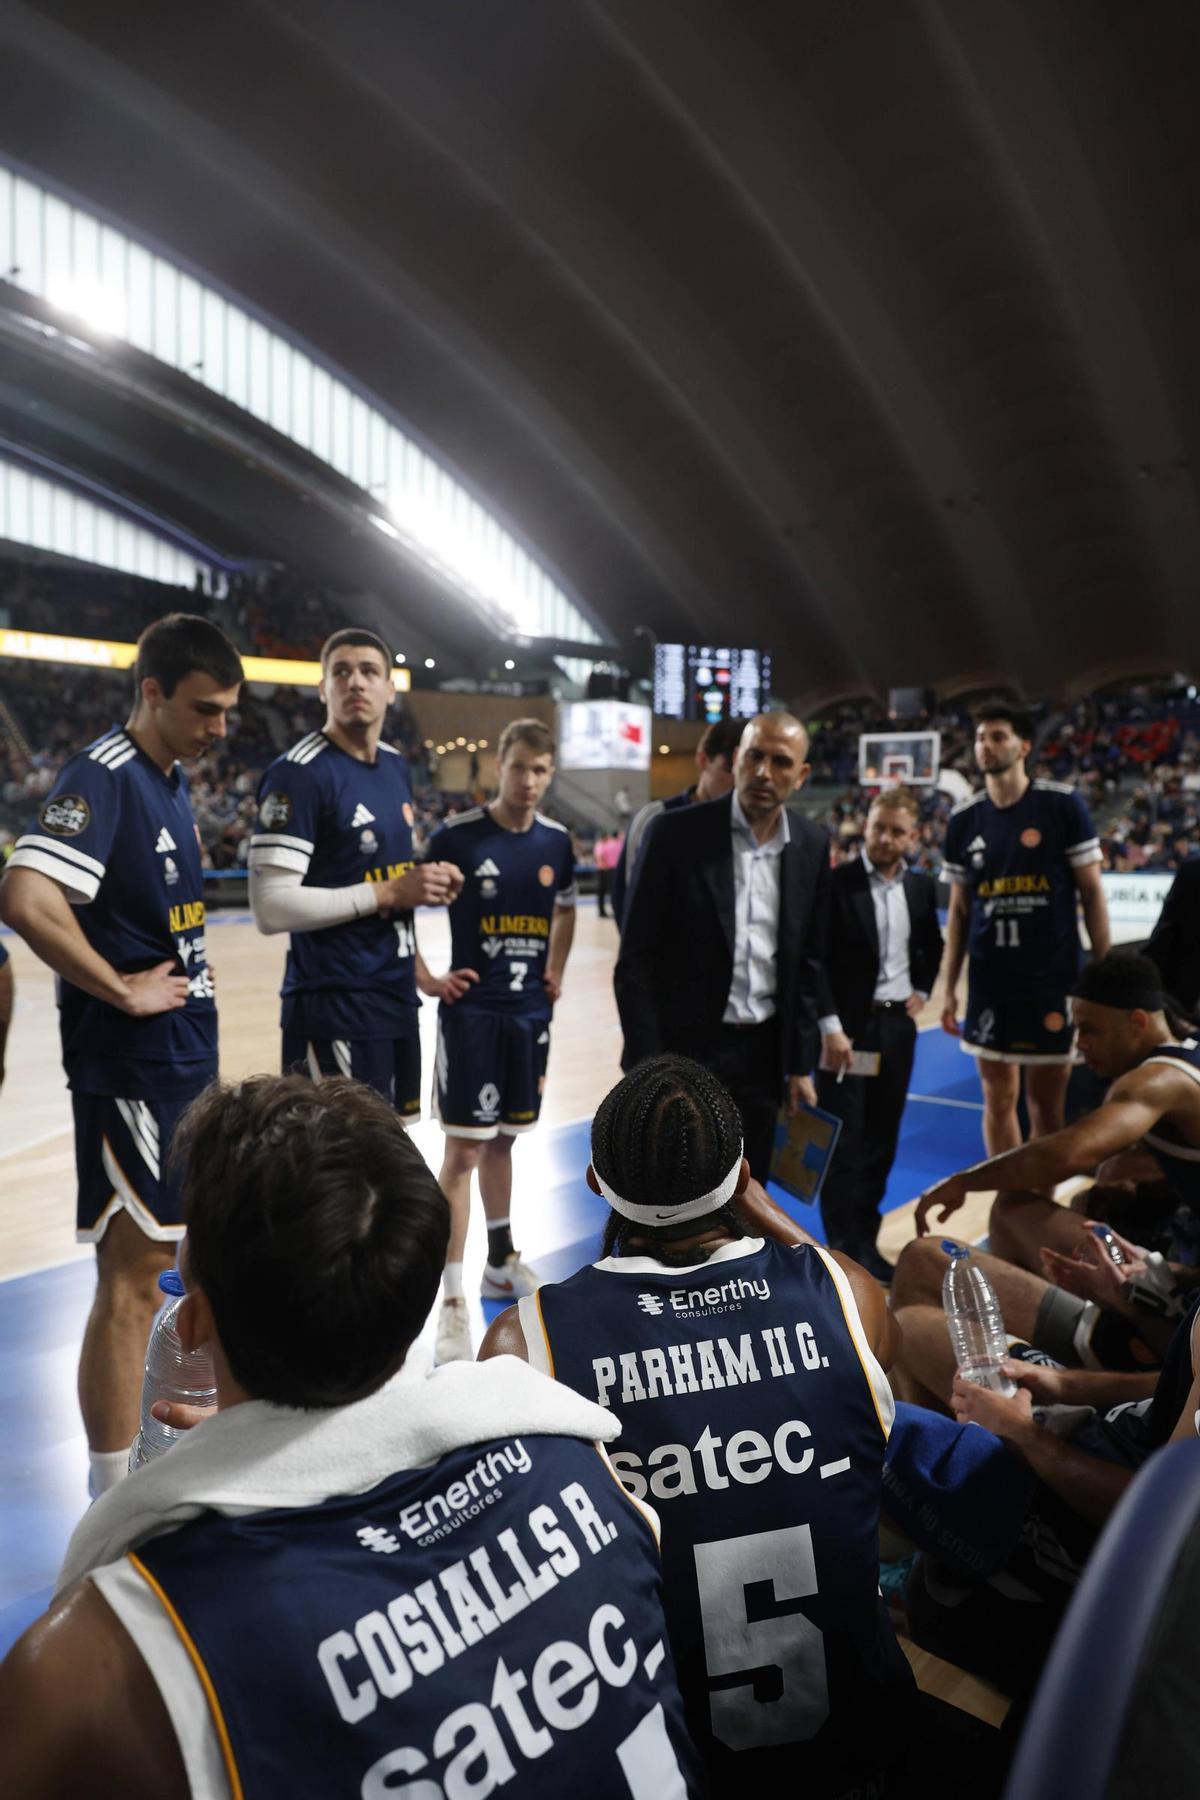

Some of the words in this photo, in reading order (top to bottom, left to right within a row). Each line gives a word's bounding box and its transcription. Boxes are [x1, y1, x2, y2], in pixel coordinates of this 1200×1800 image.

[995, 919, 1020, 947] 11
[509, 962, 528, 991] 7
[669, 1278, 771, 1311] Enerthy
[675, 1302, 742, 1319] consultores
[592, 1333, 762, 1407] PARHAM
[796, 1321, 830, 1370] G.
[399, 1439, 532, 1540] Enerthy
[417, 1487, 503, 1547] consultores
[317, 1504, 581, 1725] COSIALLS
[560, 1481, 619, 1555] R.
[693, 1523, 830, 1752] 5
